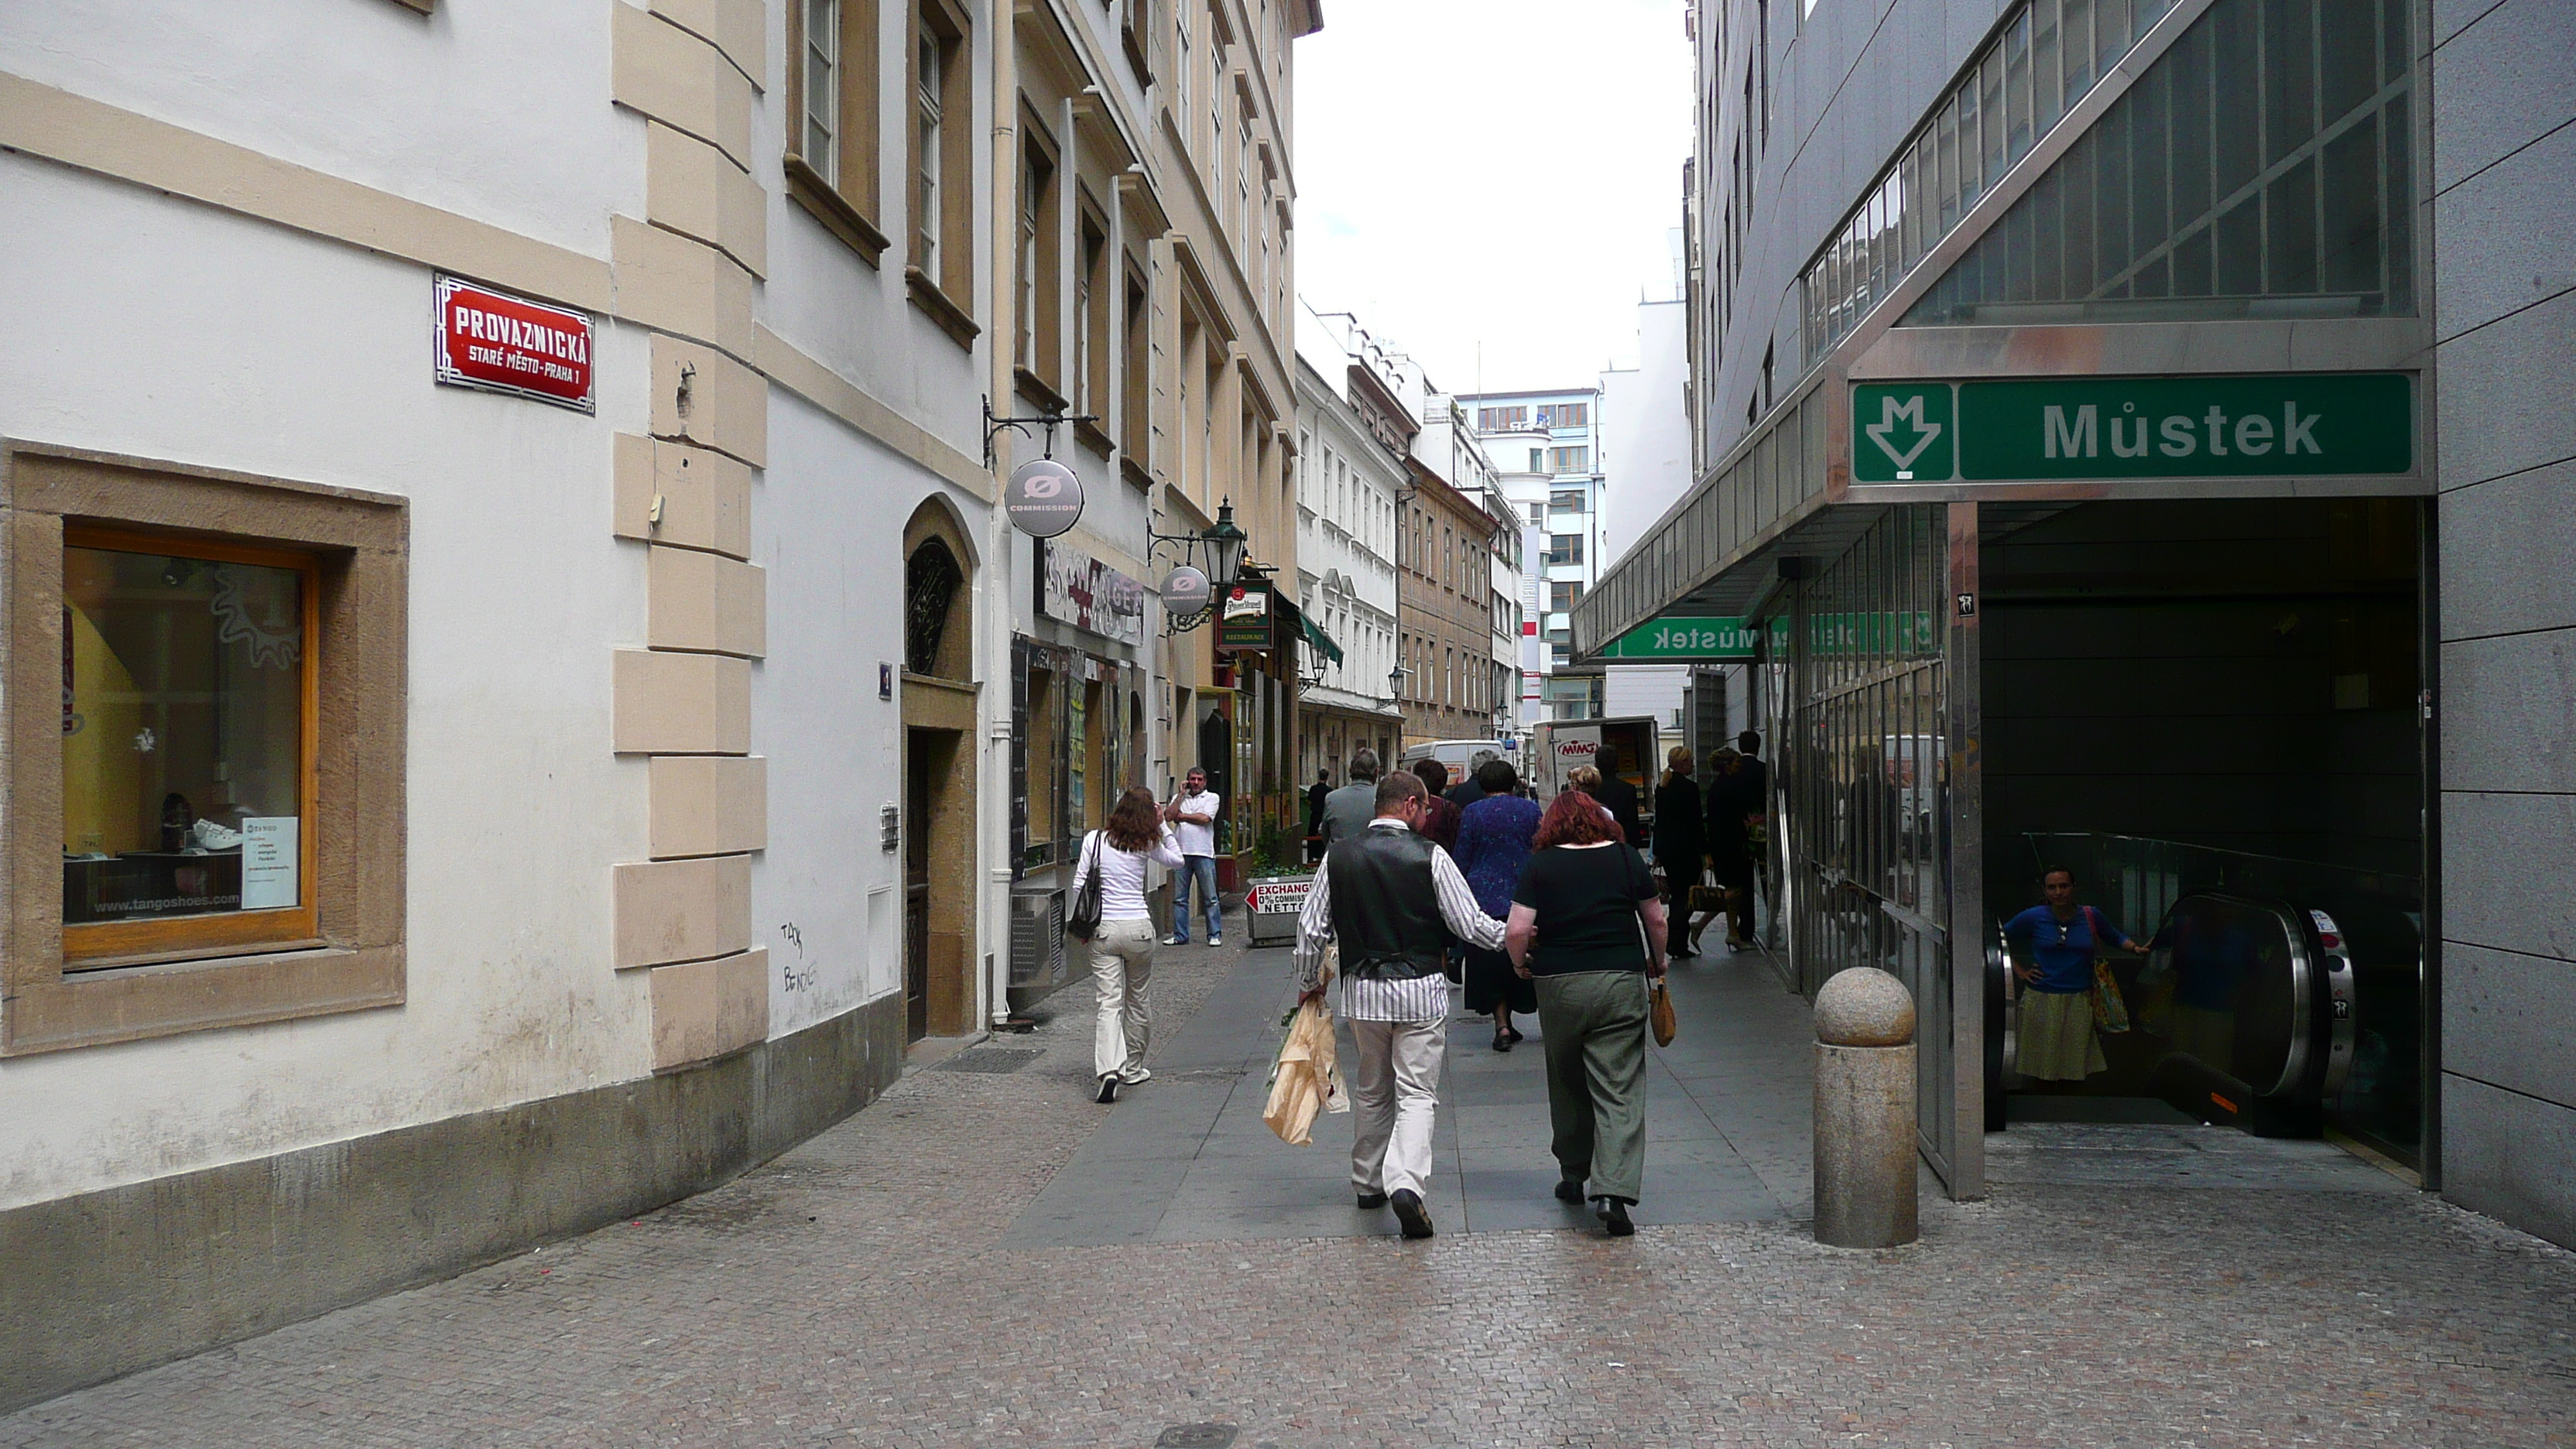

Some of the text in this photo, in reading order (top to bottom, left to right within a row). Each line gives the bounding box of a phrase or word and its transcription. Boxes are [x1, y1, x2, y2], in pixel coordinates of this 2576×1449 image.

[455, 306, 587, 365] PROVAZNICKÁ
[469, 345, 503, 366] STARÉ
[575, 370, 580, 384] 1
[2043, 401, 2322, 458] Můstek
[94, 895, 240, 912] www.tangoshoes.com
[1258, 884, 1313, 896] EXCHANG
[1275, 894, 1307, 903] COMMISS
